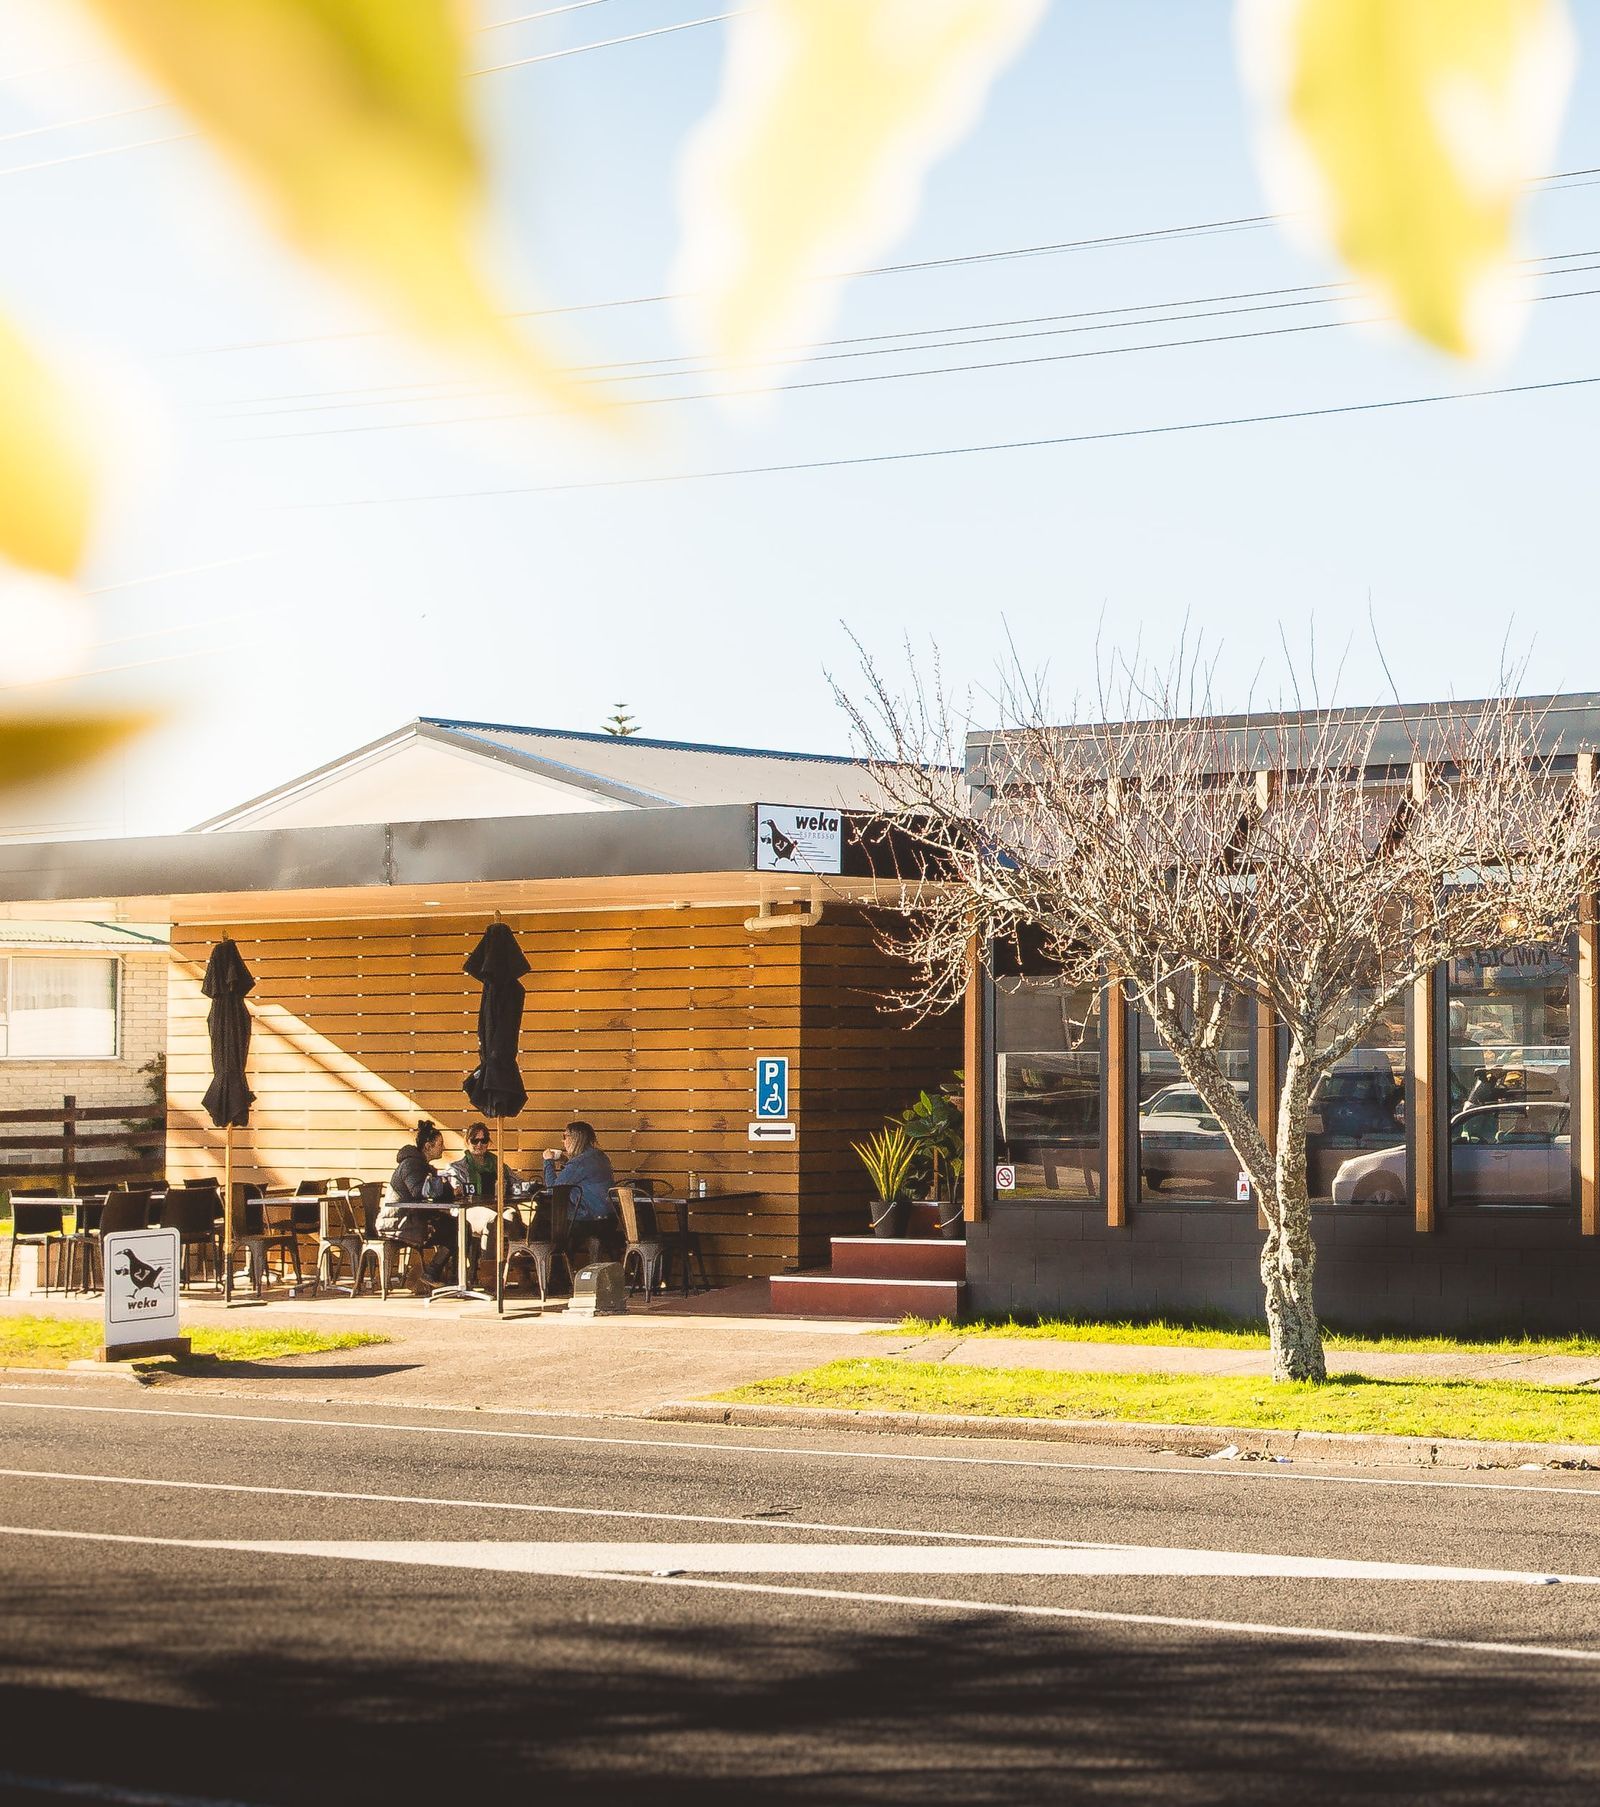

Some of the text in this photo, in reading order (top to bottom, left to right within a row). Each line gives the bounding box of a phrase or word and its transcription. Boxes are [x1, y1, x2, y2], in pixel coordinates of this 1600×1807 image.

[795, 811, 839, 832] weka
[799, 831, 835, 840] ESPRESSO
[765, 1062, 779, 1085] P
[465, 1184, 475, 1194] 13
[127, 1296, 158, 1310] weka
